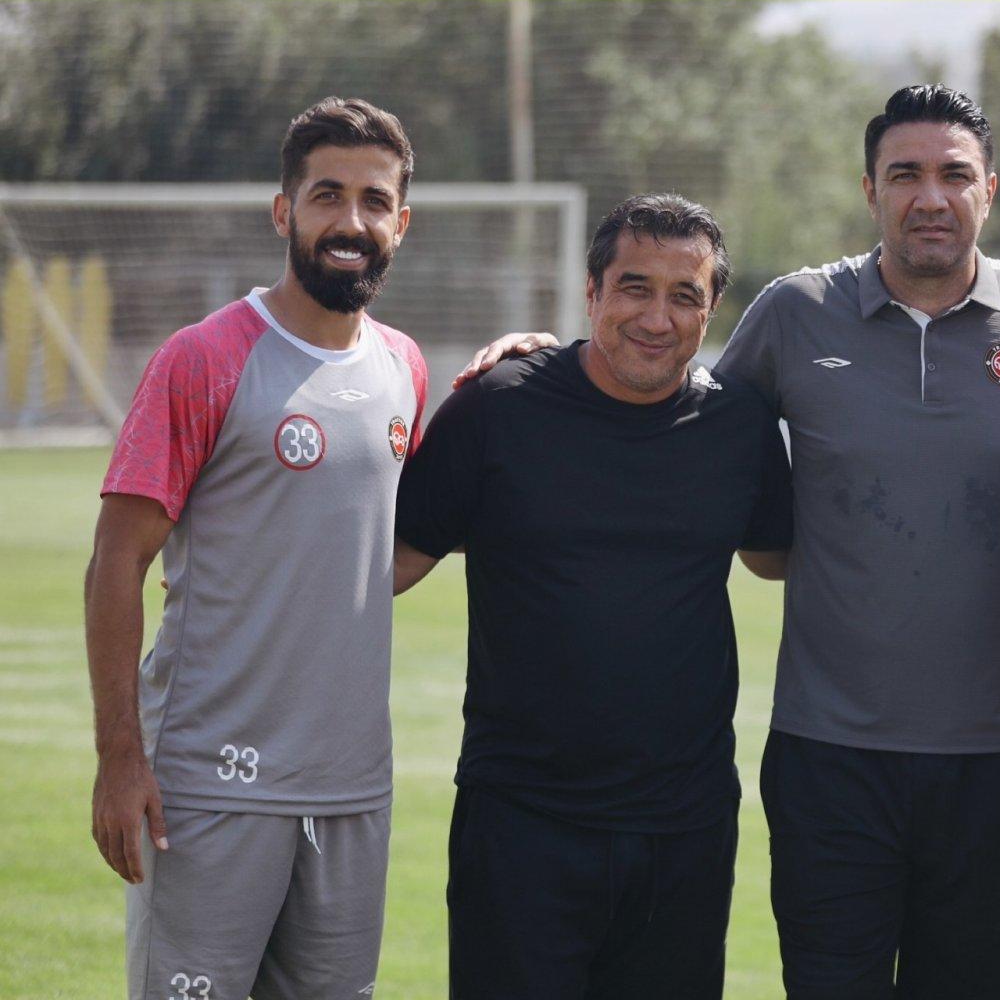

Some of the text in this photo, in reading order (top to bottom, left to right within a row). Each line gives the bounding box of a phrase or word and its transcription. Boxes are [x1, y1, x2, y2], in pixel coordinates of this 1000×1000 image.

[281, 423, 321, 463] 33
[216, 743, 260, 784] 33
[169, 972, 212, 1000] 33
